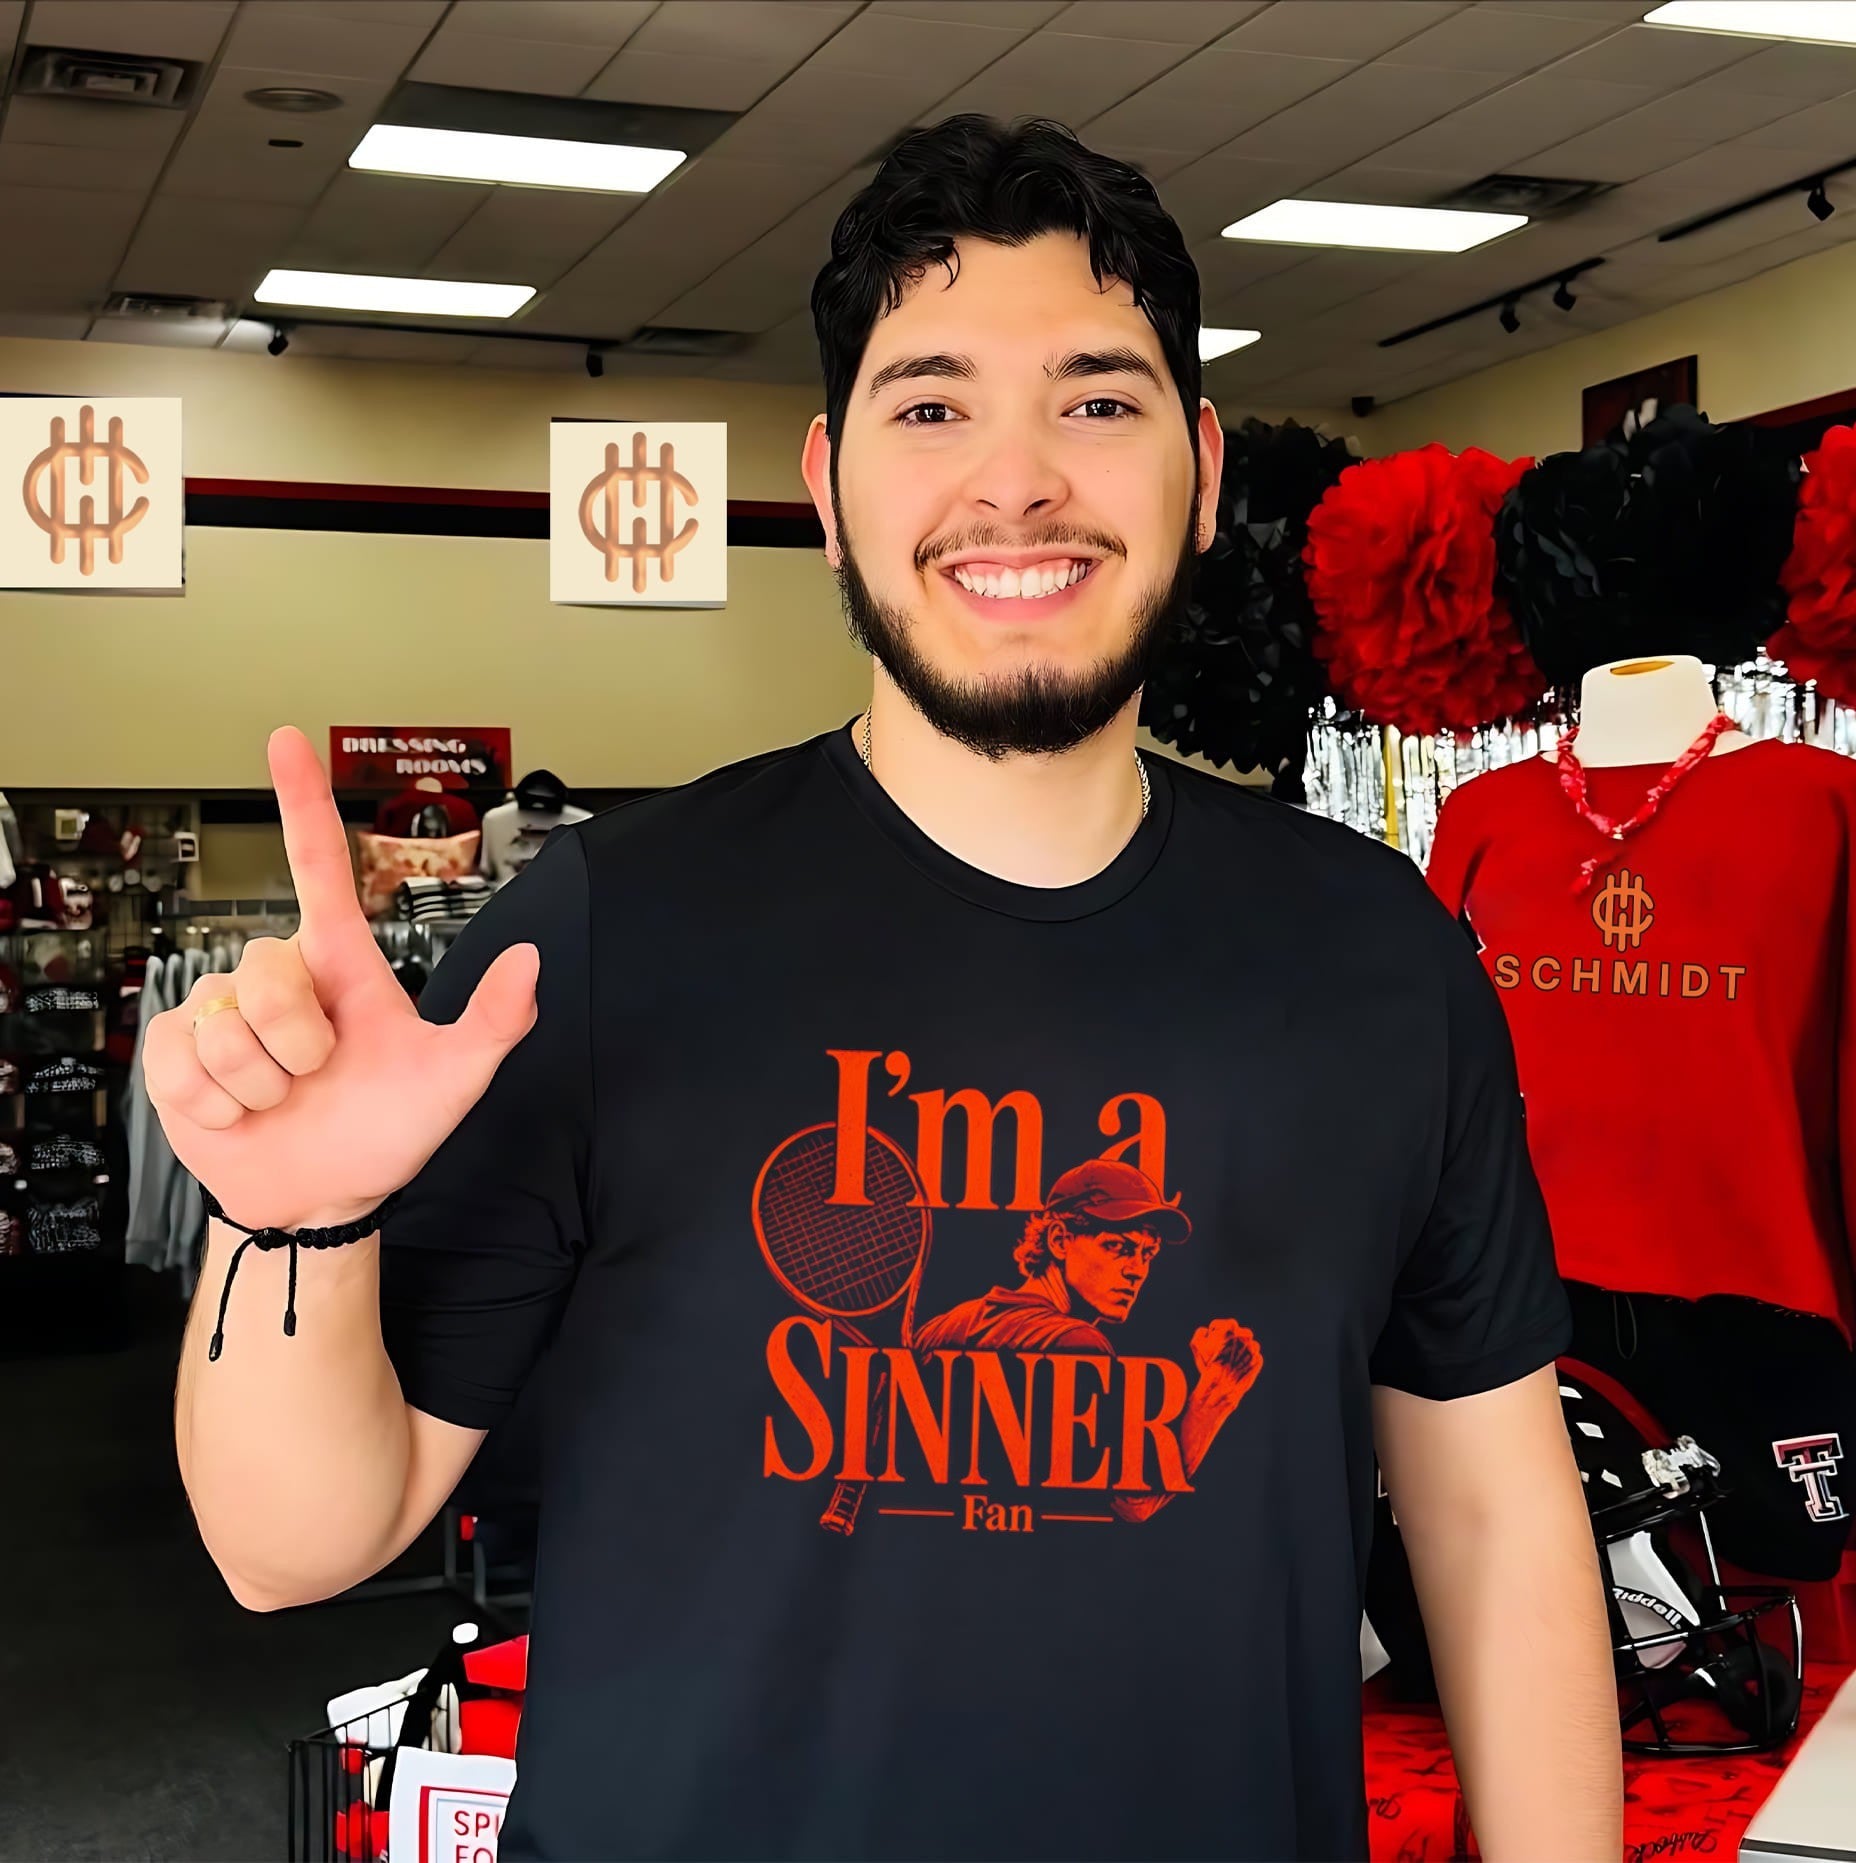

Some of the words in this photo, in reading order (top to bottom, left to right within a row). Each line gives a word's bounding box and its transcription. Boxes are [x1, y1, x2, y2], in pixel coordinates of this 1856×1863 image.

[342, 737, 467, 754] DRESSING
[396, 758, 487, 775] ROOMS
[1494, 953, 1747, 1000] SCHMIDT
[824, 1049, 1046, 1212] I'm
[1097, 1092, 1182, 1208] a
[763, 1315, 1196, 1493] SINNER
[961, 1495, 1035, 1534] Fan
